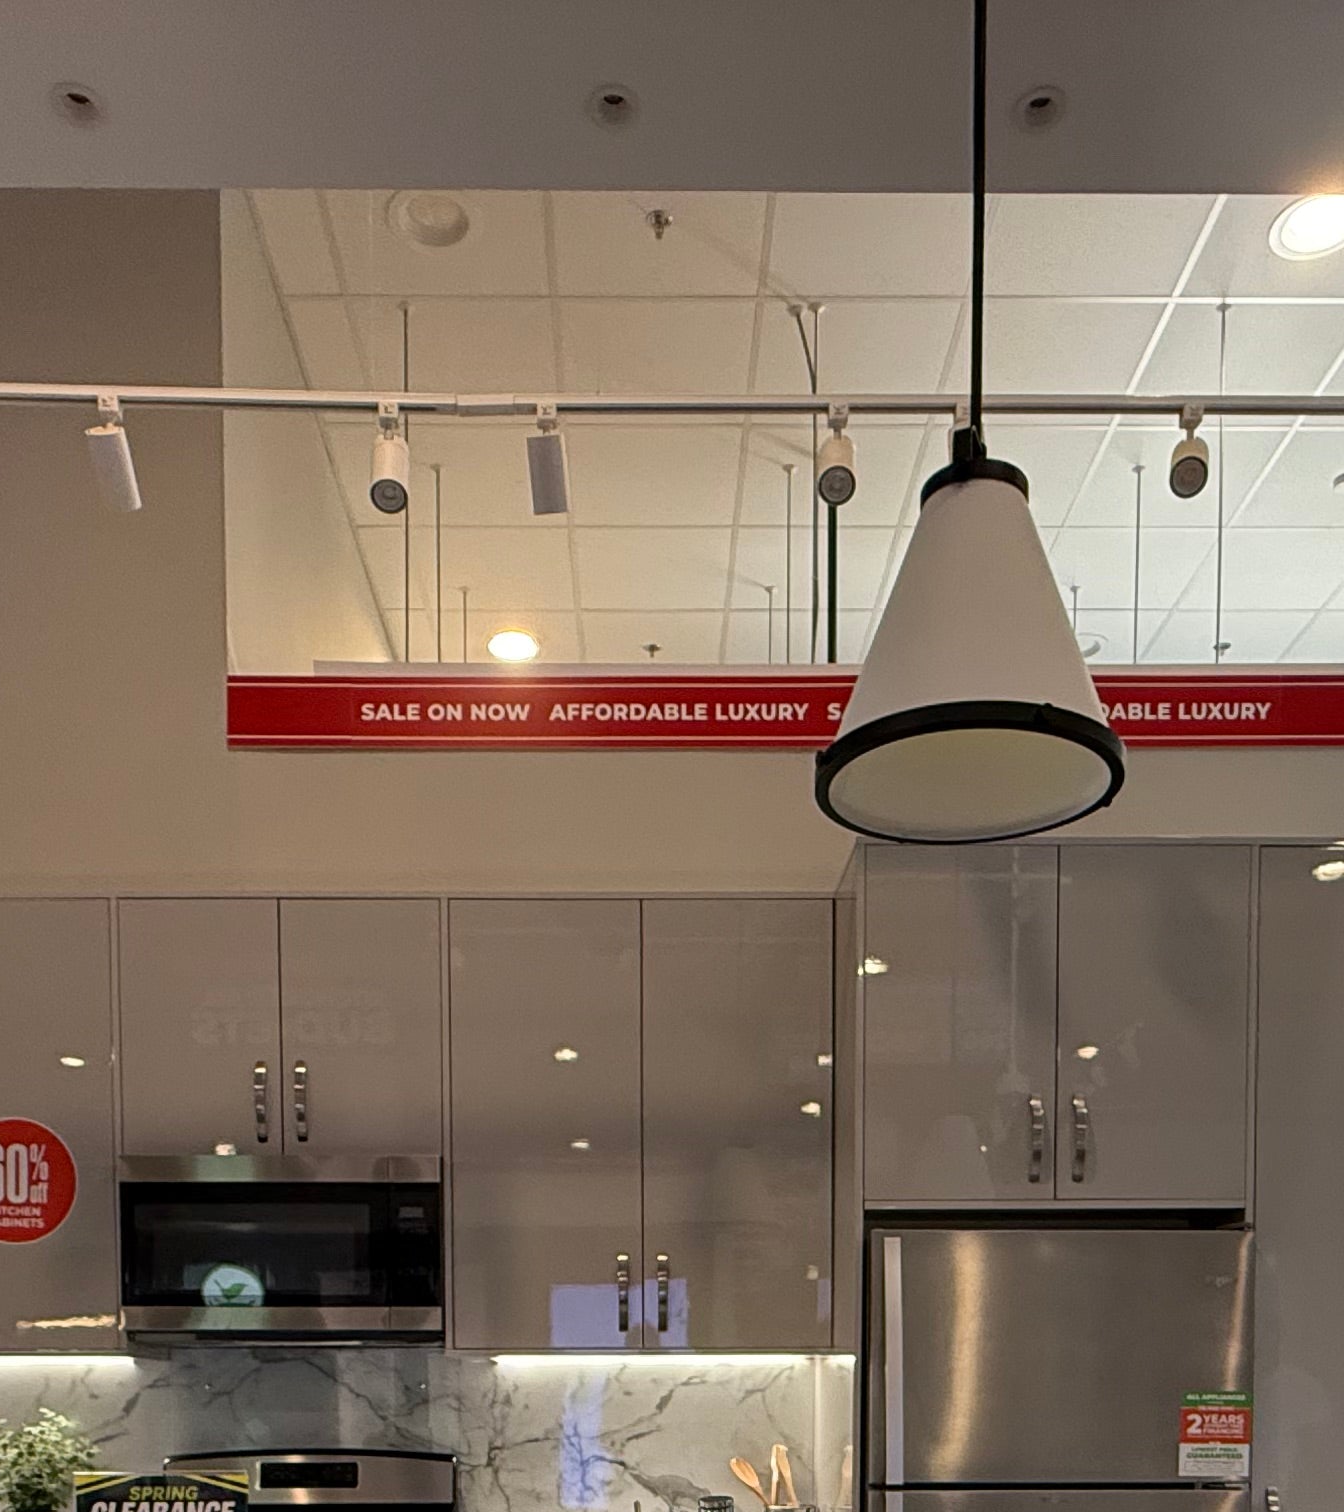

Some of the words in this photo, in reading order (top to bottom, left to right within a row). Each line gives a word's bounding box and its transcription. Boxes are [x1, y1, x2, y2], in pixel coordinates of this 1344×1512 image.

[360, 702, 421, 721] SALE
[427, 702, 463, 721] ON
[470, 702, 531, 721] NOW
[548, 702, 708, 721] AFFORDABLE
[714, 702, 809, 721] LUXURY
[1178, 702, 1272, 720] LUXURY
[1186, 1413, 1203, 1435] 2
[1203, 1414, 1245, 1424] YEARS
[128, 1485, 199, 1501] SPRING
